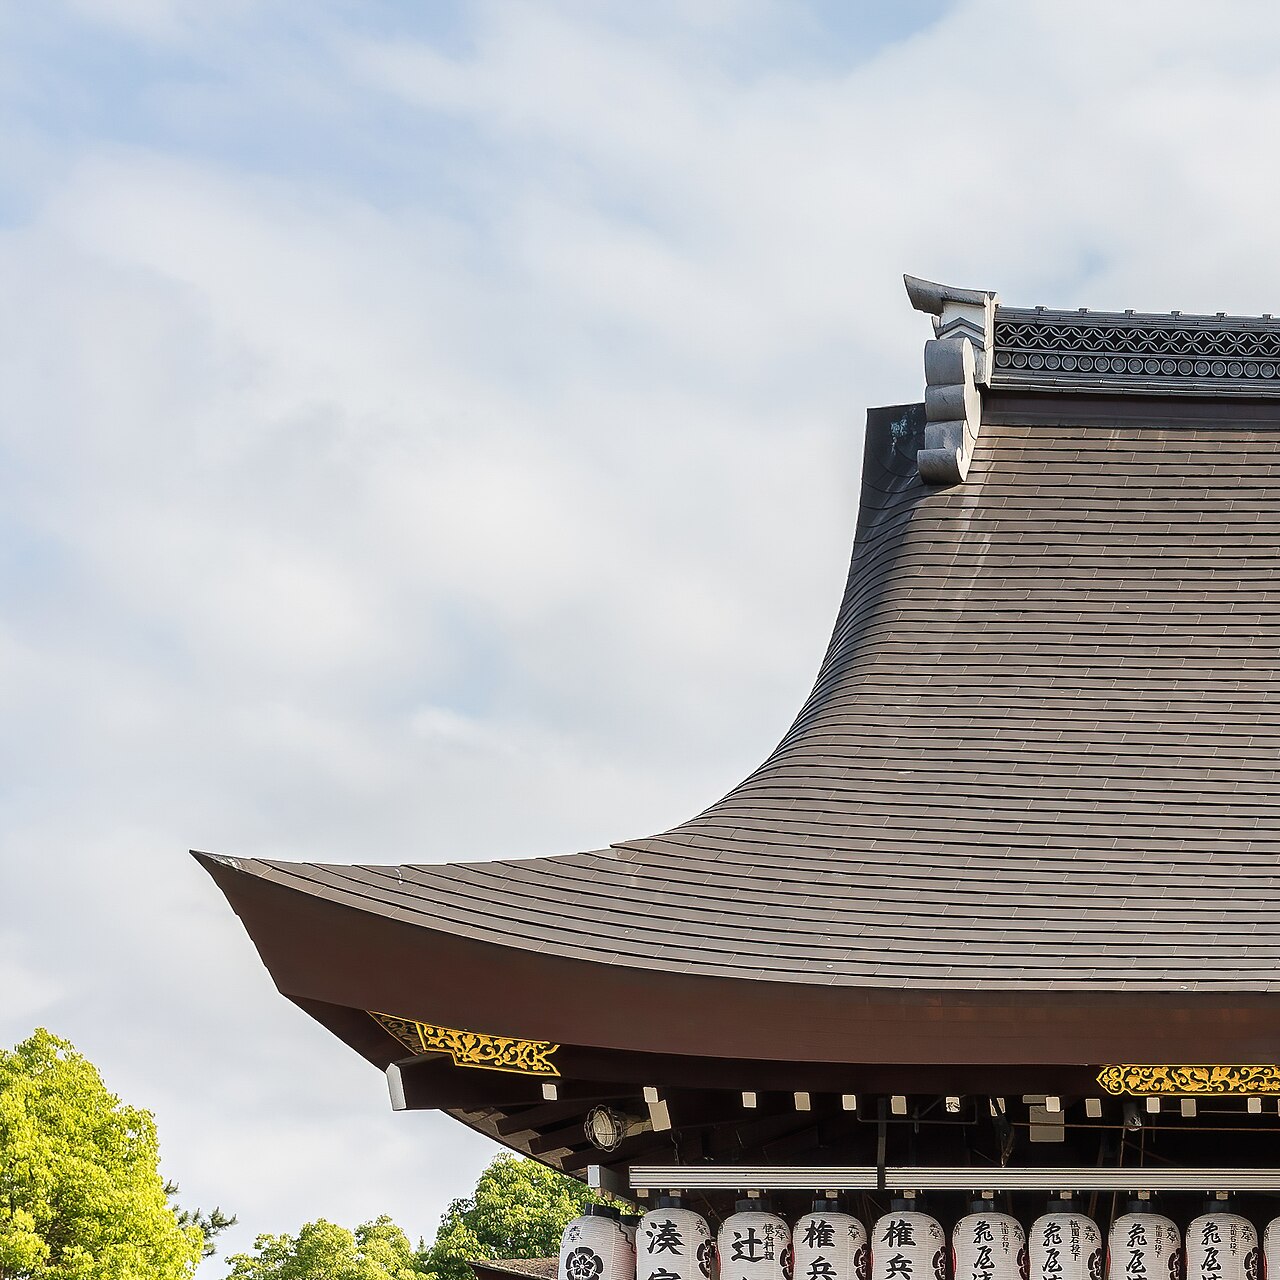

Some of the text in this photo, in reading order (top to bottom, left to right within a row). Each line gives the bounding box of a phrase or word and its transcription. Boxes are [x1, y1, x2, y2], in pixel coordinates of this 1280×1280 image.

[1069, 1220, 1081, 1261] 祇園石段下
